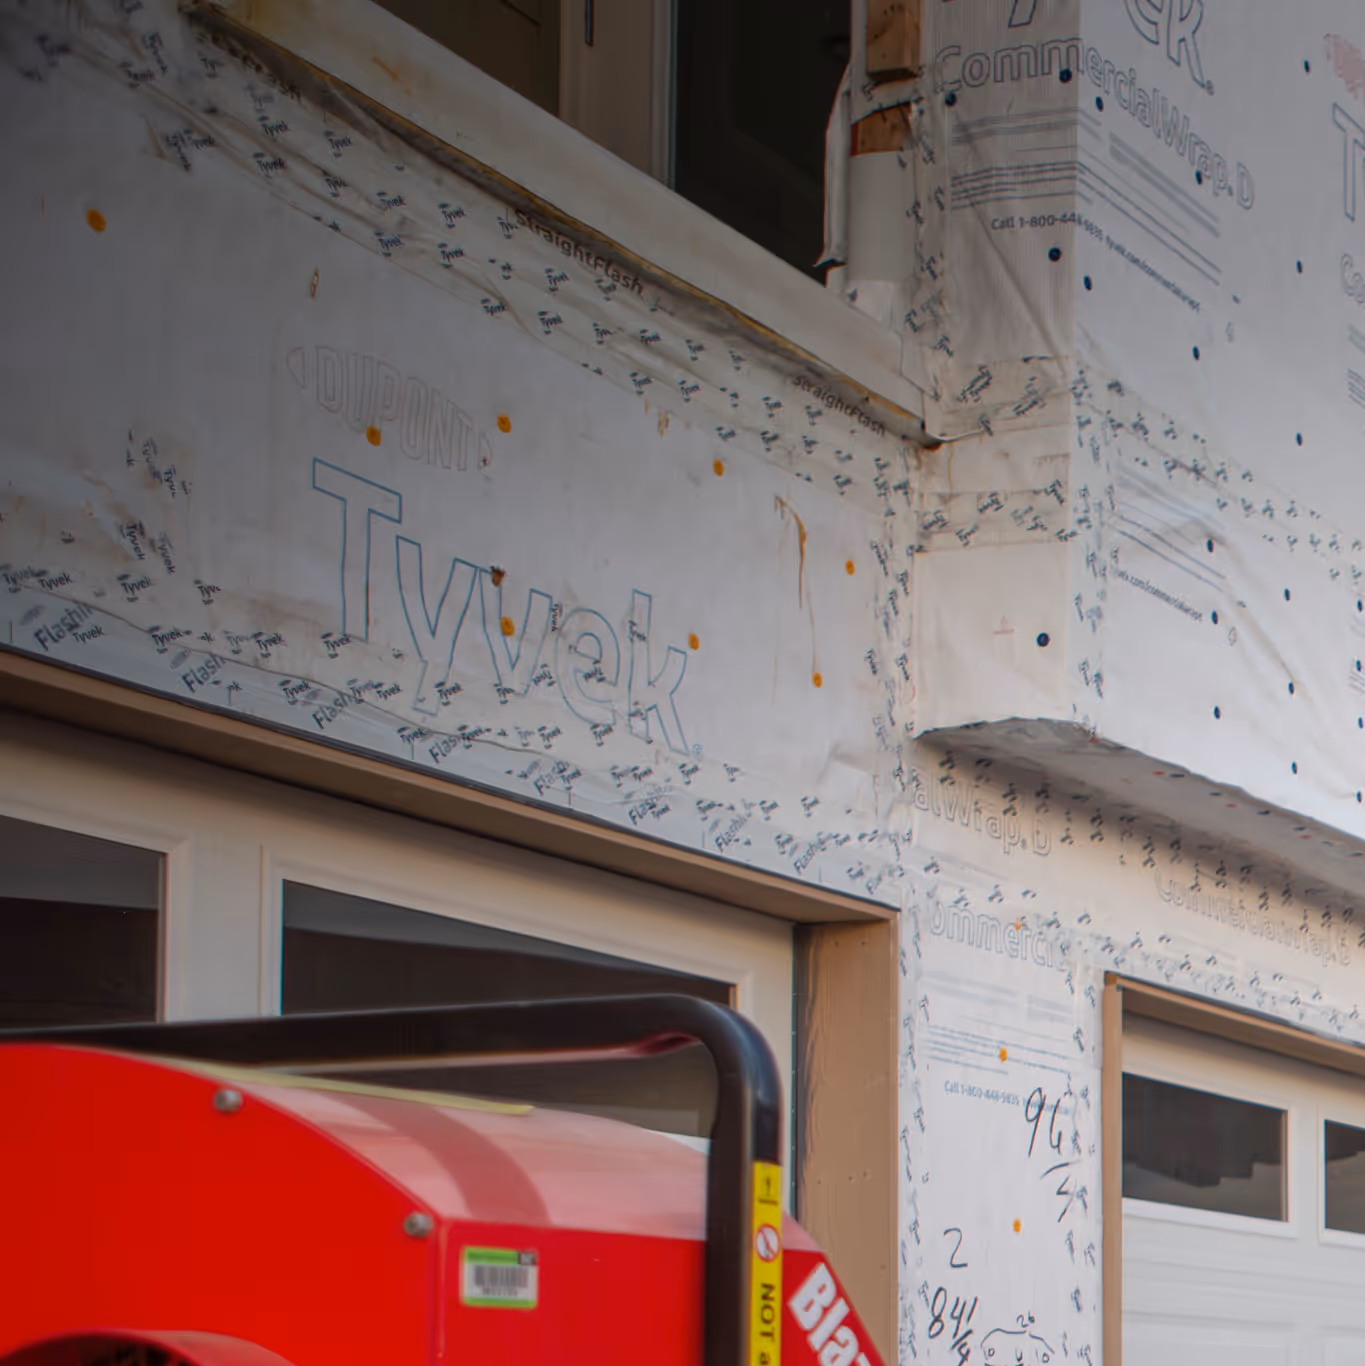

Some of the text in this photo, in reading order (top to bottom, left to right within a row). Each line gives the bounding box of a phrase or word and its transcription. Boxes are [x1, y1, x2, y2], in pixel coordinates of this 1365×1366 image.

[514, 208, 645, 296] StraightFlash
[991, 216, 1015, 231] Call
[39, 571, 73, 591] Tyvek
[312, 456, 691, 757] Tyvek
[760, 1283, 776, 1344] NOT
